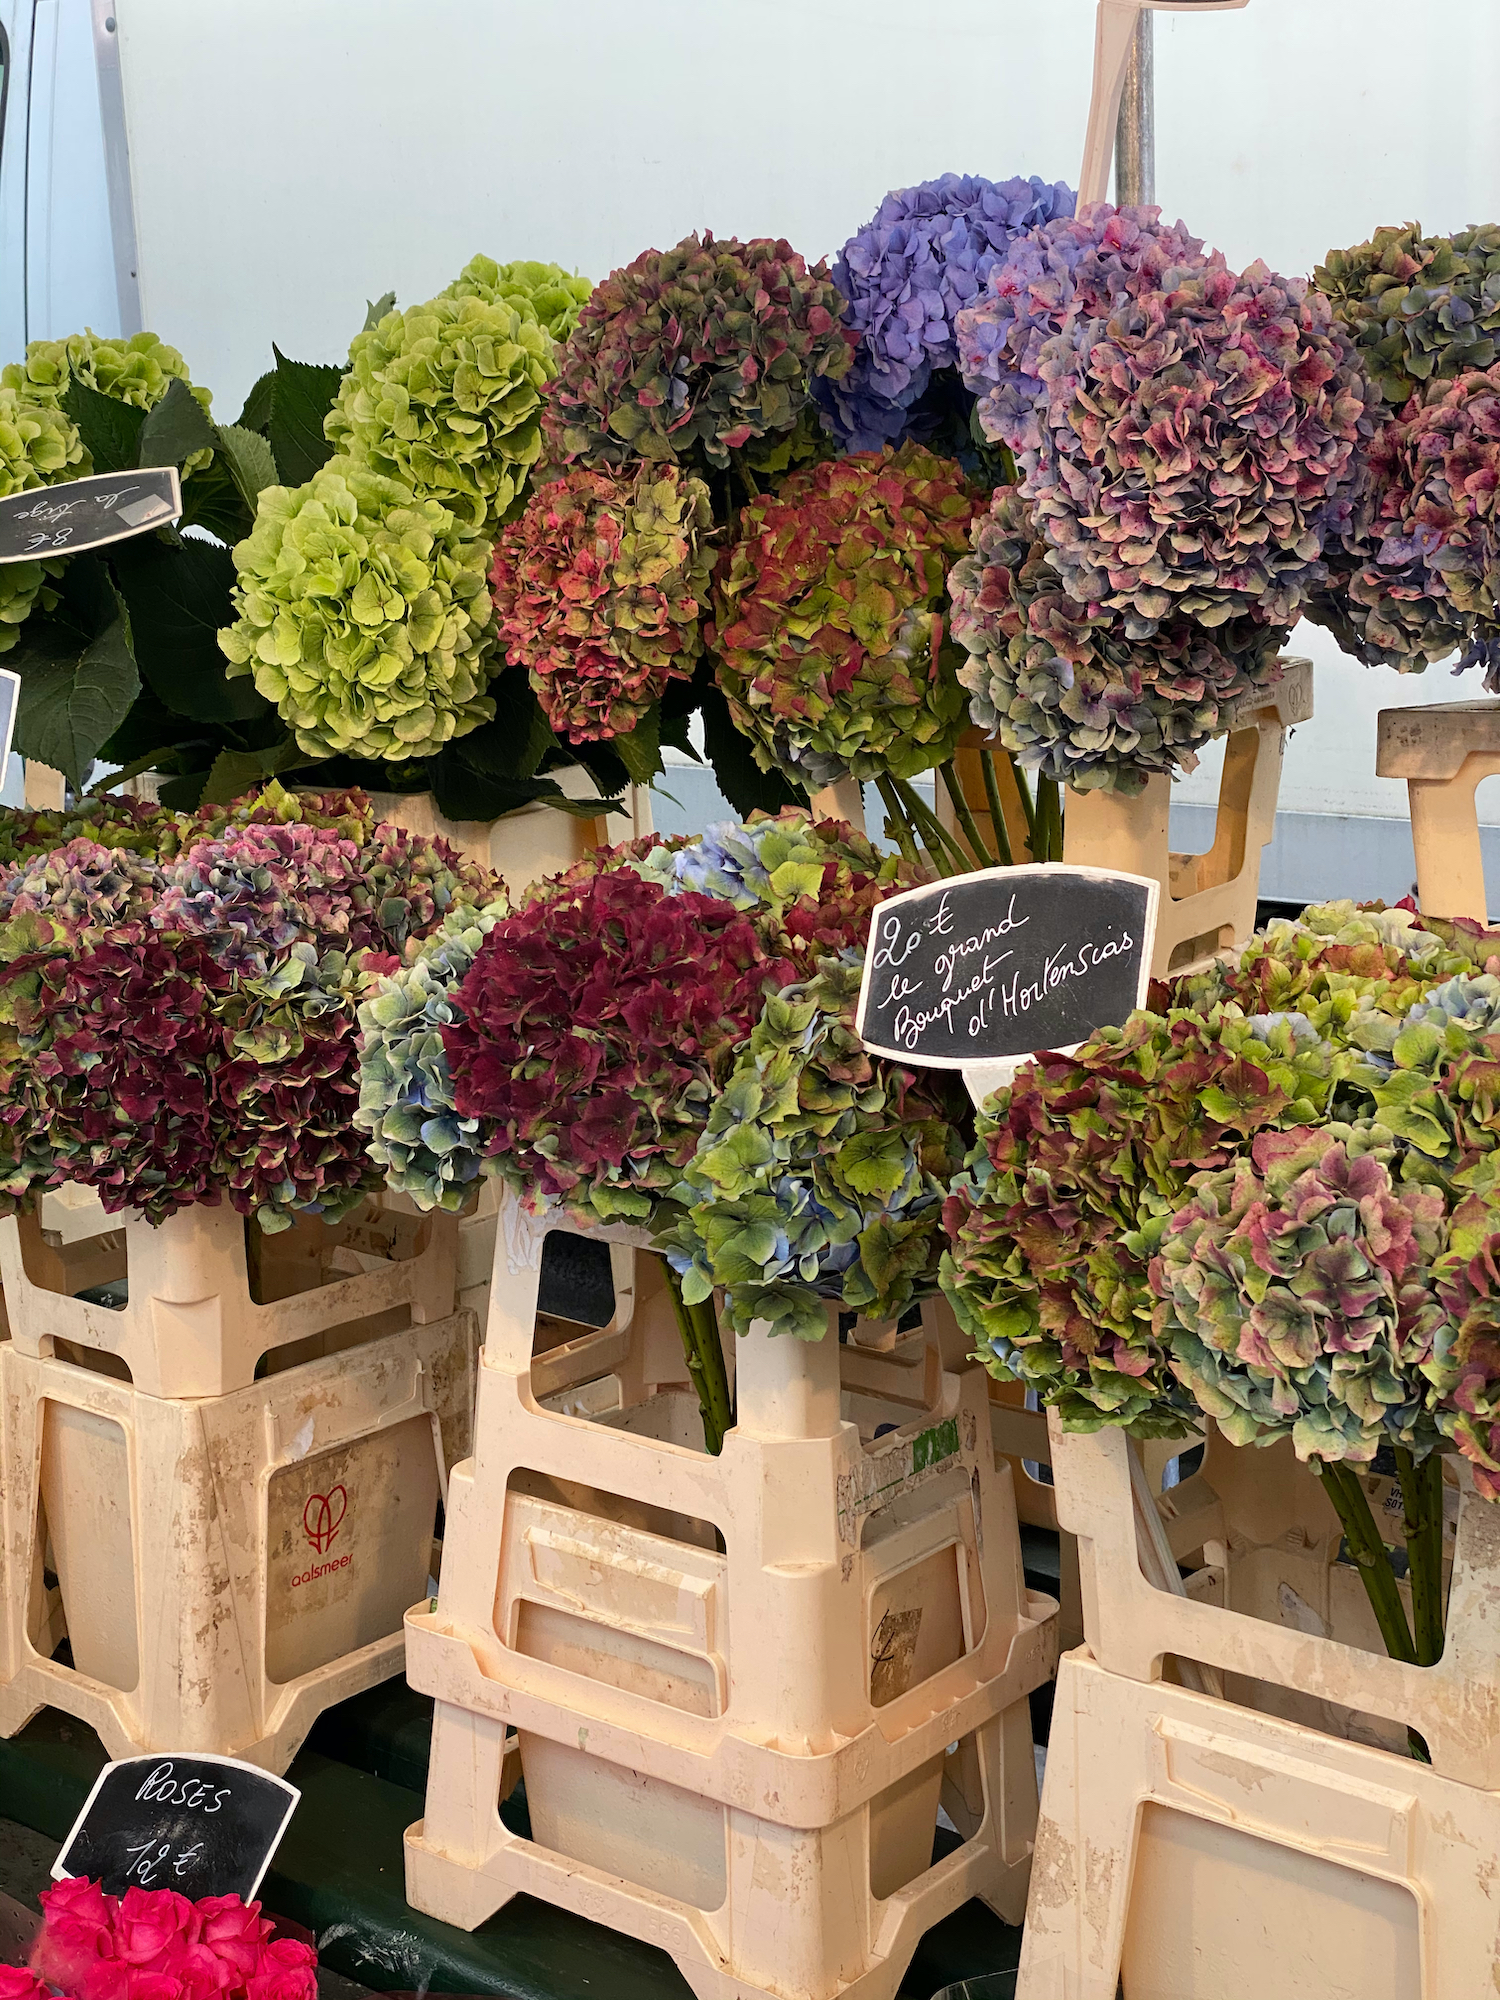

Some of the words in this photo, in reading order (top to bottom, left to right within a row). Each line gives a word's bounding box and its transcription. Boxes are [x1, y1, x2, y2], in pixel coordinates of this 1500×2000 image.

[13, 500, 87, 523] tige
[93, 485, 140, 509] la
[876, 974, 924, 1010] le
[934, 893, 1030, 993] grand
[893, 949, 1014, 1050] Bouquet
[291, 1553, 354, 1587] aalsmeer
[134, 1761, 232, 1813] ROSES
[126, 1838, 171, 1885] 12
[172, 1842, 205, 1876] €
